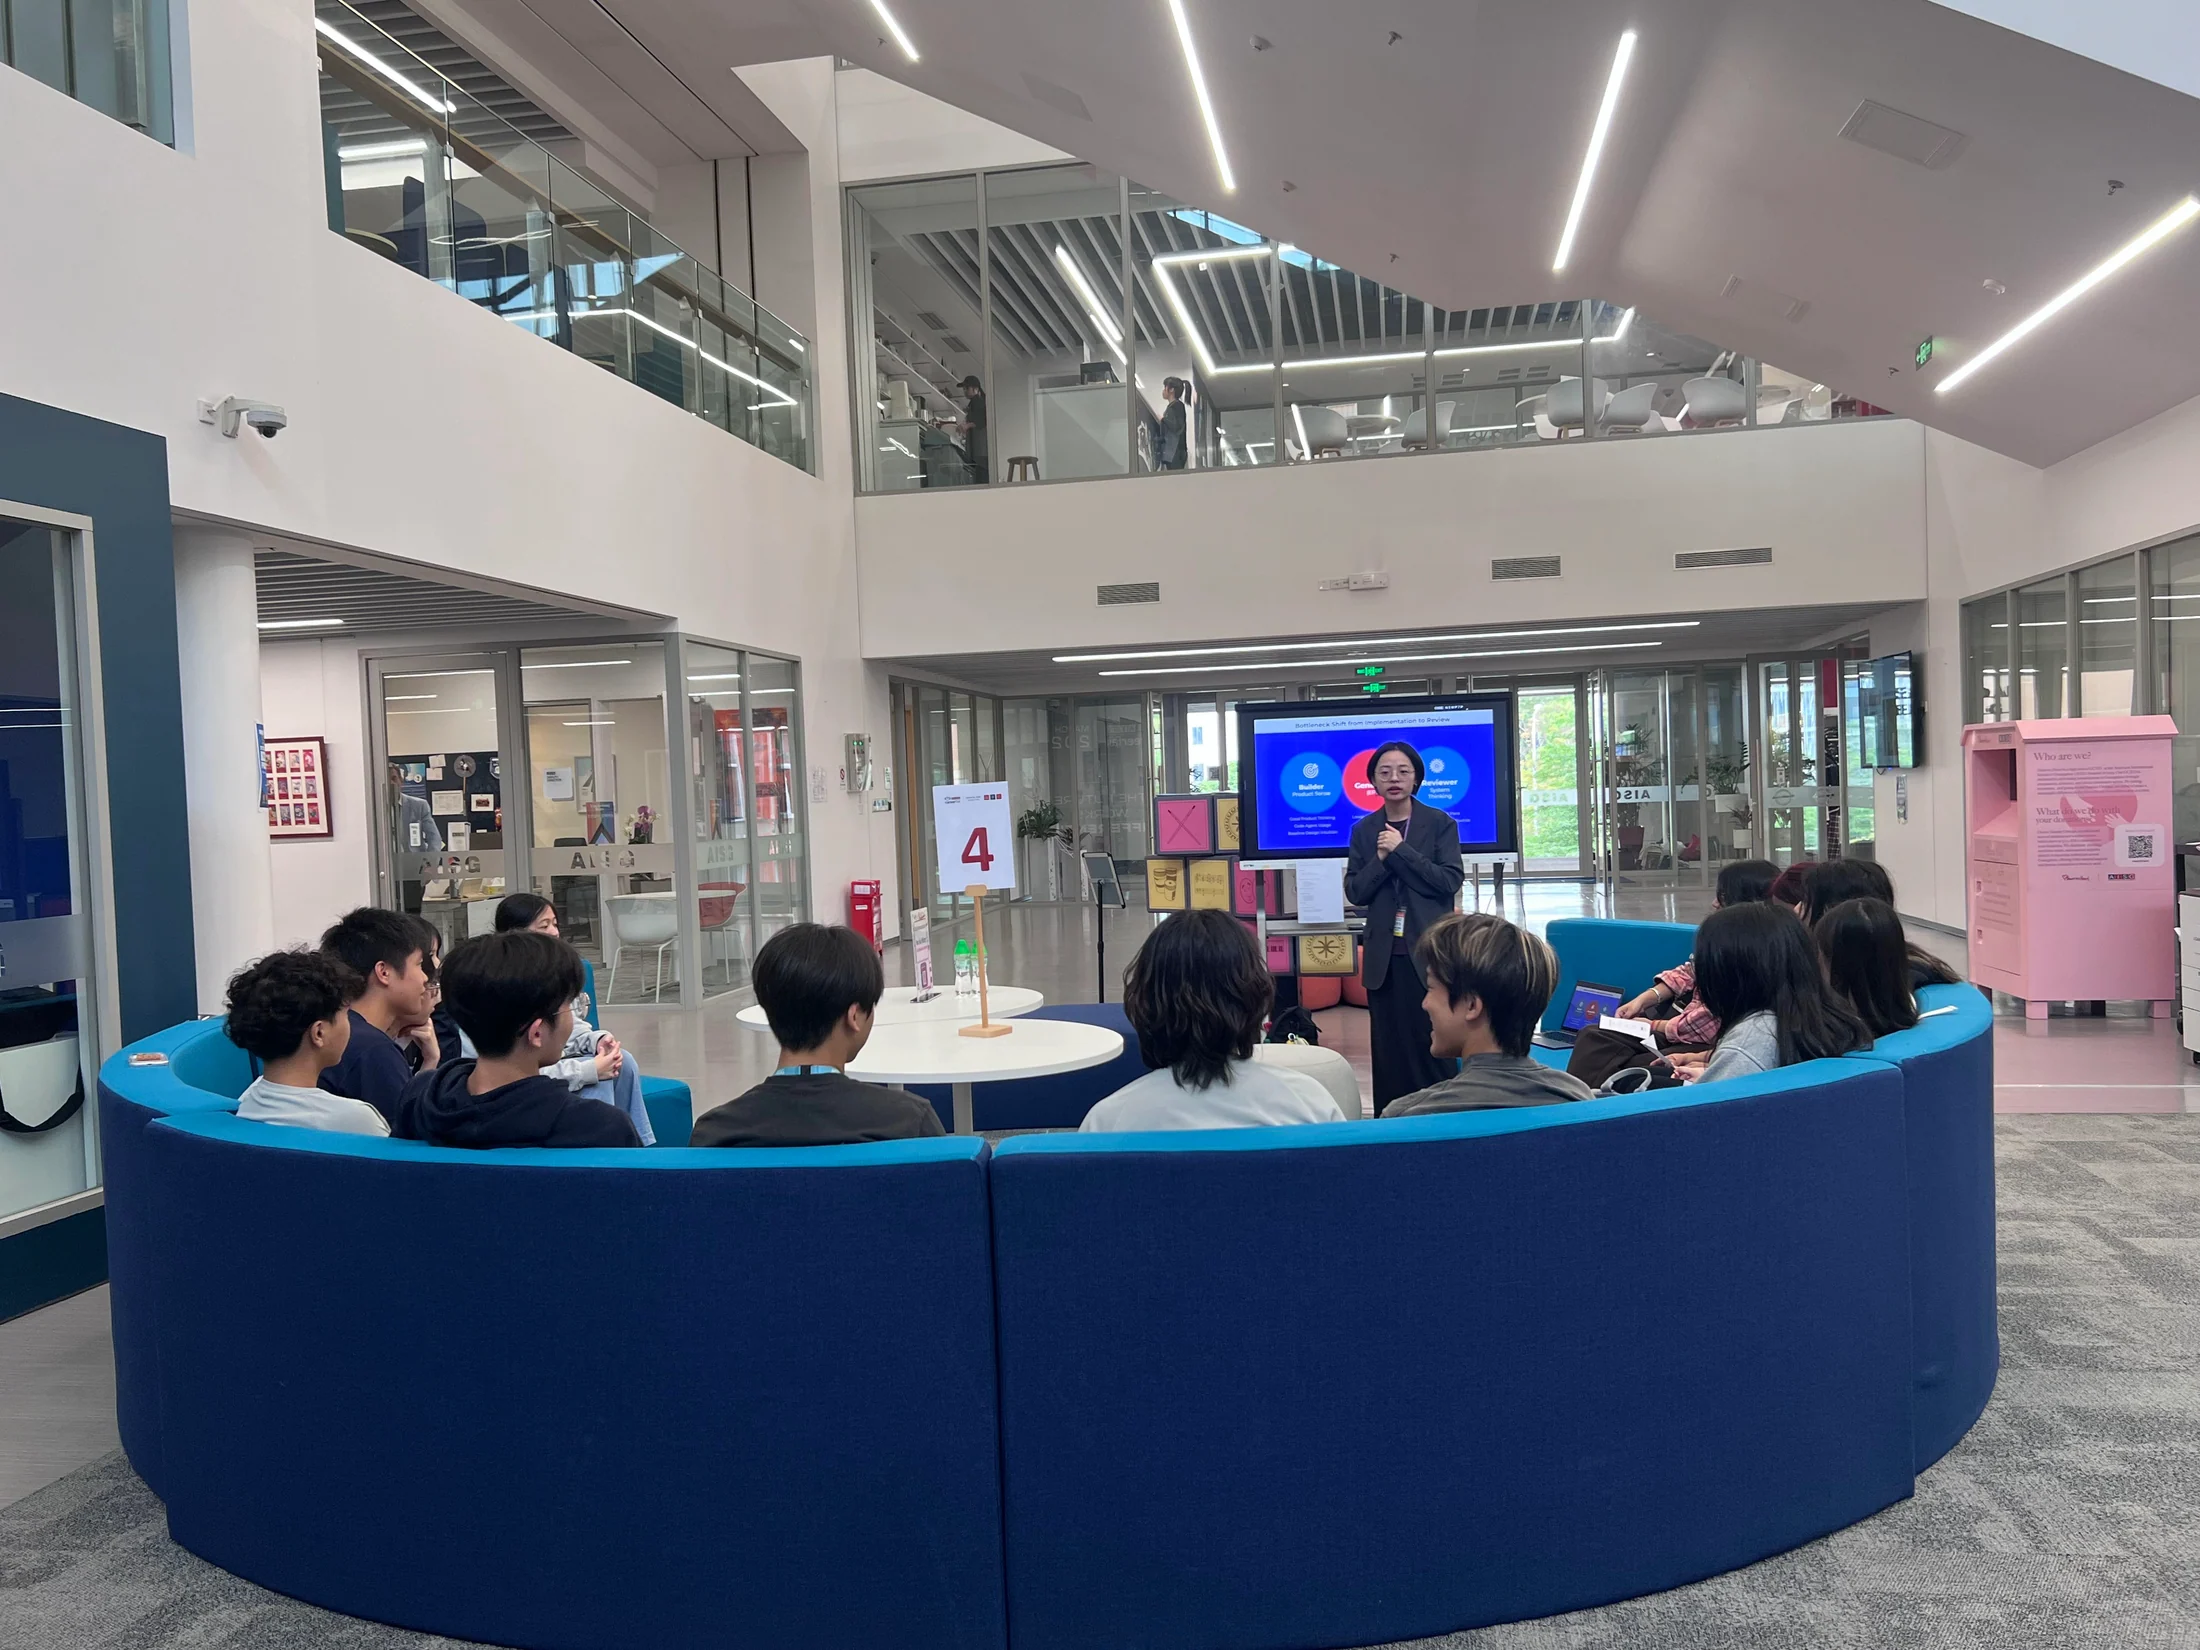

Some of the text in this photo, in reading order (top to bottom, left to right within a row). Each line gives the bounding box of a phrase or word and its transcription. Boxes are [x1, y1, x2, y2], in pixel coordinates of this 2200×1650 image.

[1365, 718, 1417, 726] Implementation
[2034, 752, 2056, 761] Who
[2074, 752, 2092, 760] we?
[1421, 779, 1458, 787] Reviewer
[2036, 807, 2060, 816] What
[2061, 807, 2073, 815] do
[2074, 807, 2087, 815] we
[2101, 806, 2120, 814] with
[2035, 817, 2052, 825] your
[961, 827, 994, 871] 4
[707, 845, 734, 864] AISG
[418, 856, 481, 875] AISG
